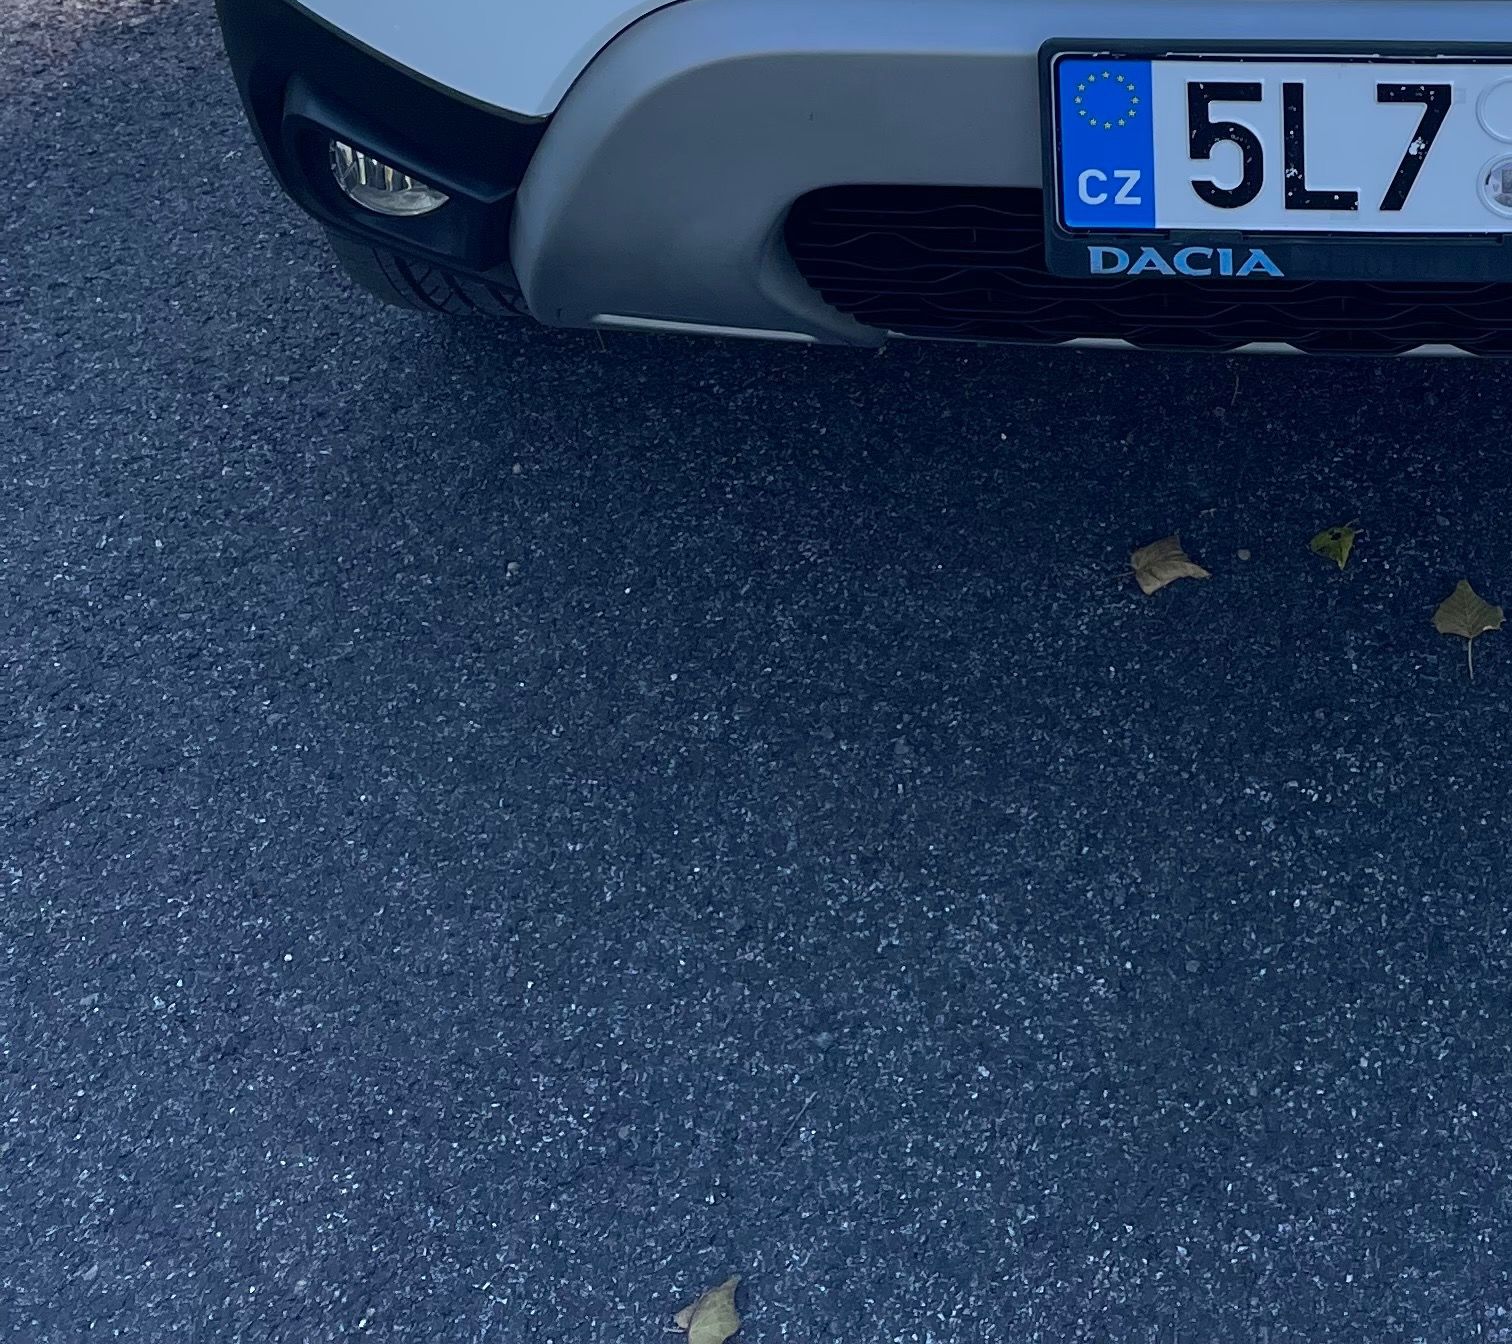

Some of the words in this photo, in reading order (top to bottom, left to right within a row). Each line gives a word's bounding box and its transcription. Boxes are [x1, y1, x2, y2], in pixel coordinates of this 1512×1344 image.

[1186, 80, 1454, 211] 5L7
[1077, 168, 1142, 206] CZ
[1086, 245, 1285, 277] DACIA
